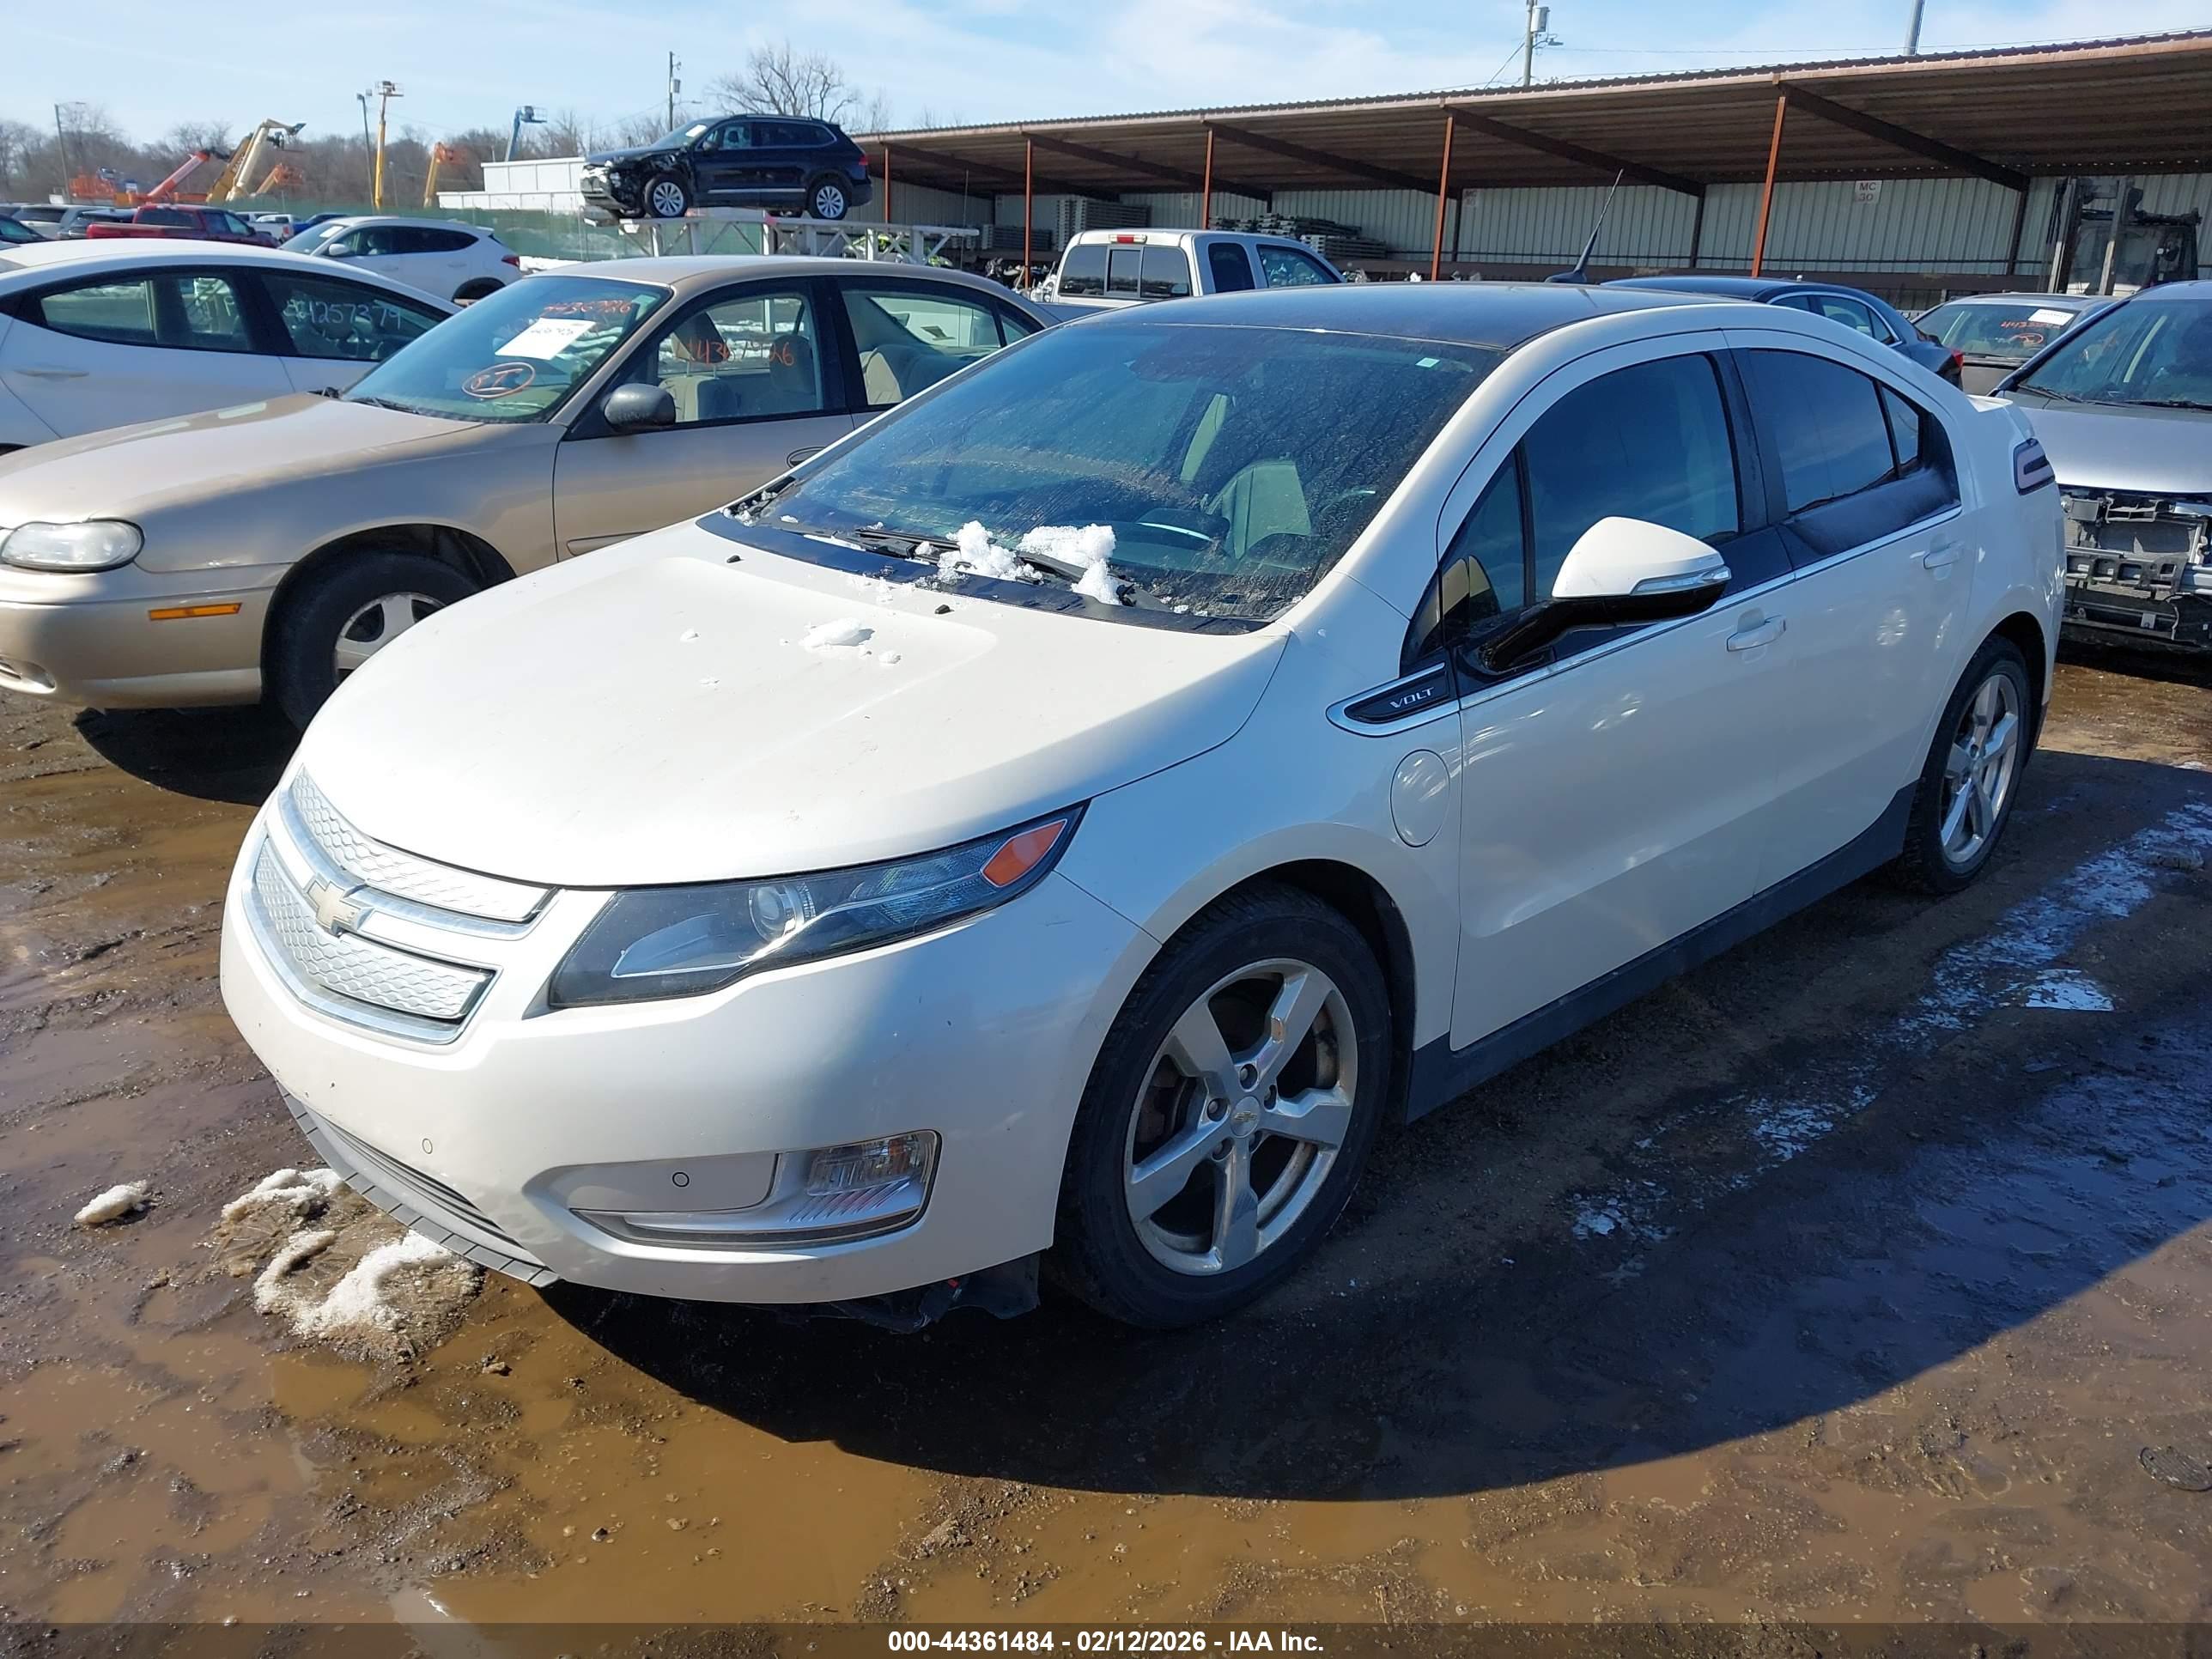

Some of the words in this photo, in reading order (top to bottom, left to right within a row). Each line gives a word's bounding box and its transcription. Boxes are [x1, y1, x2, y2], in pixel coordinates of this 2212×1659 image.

[1859, 182, 1876, 191] MC
[1860, 192, 1874, 201] 30
[1389, 687, 1435, 708] VOLT
